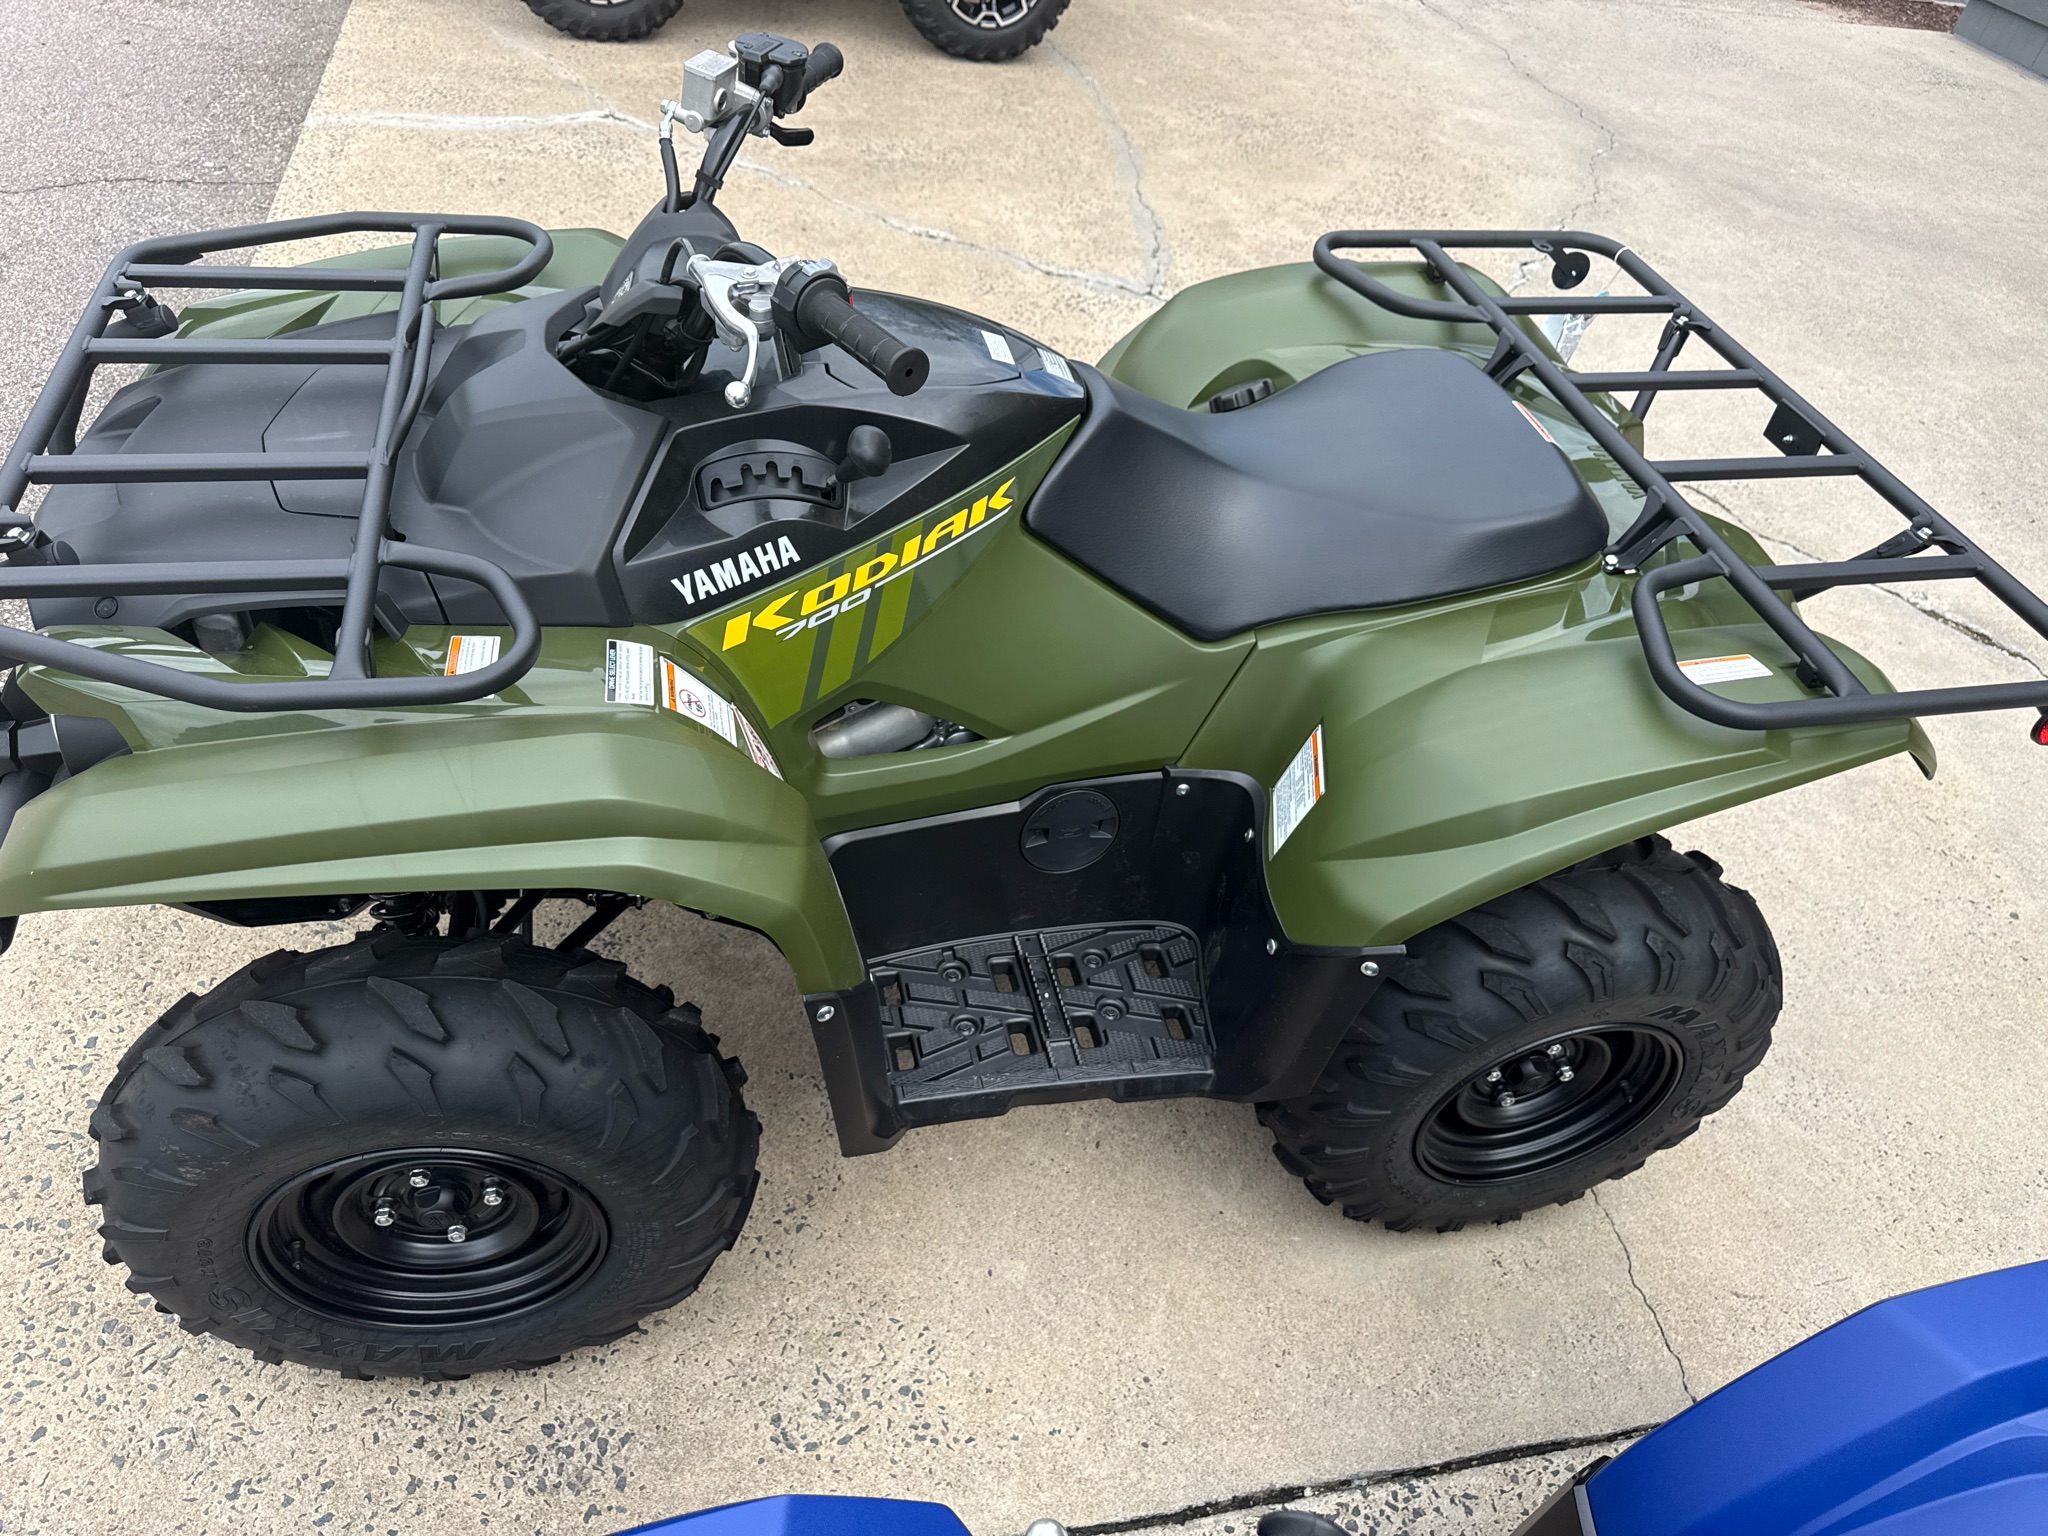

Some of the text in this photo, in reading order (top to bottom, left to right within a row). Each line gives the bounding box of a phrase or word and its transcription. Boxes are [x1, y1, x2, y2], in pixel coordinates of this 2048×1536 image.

[670, 535, 801, 605] YAMAHA
[722, 476, 1016, 651] KODIAK
[775, 588, 872, 641] 700
[608, 648, 616, 690] DRIVE SELECT LEVER
[695, 703, 703, 714] 16
[208, 1286, 496, 1363] MAXXIS
